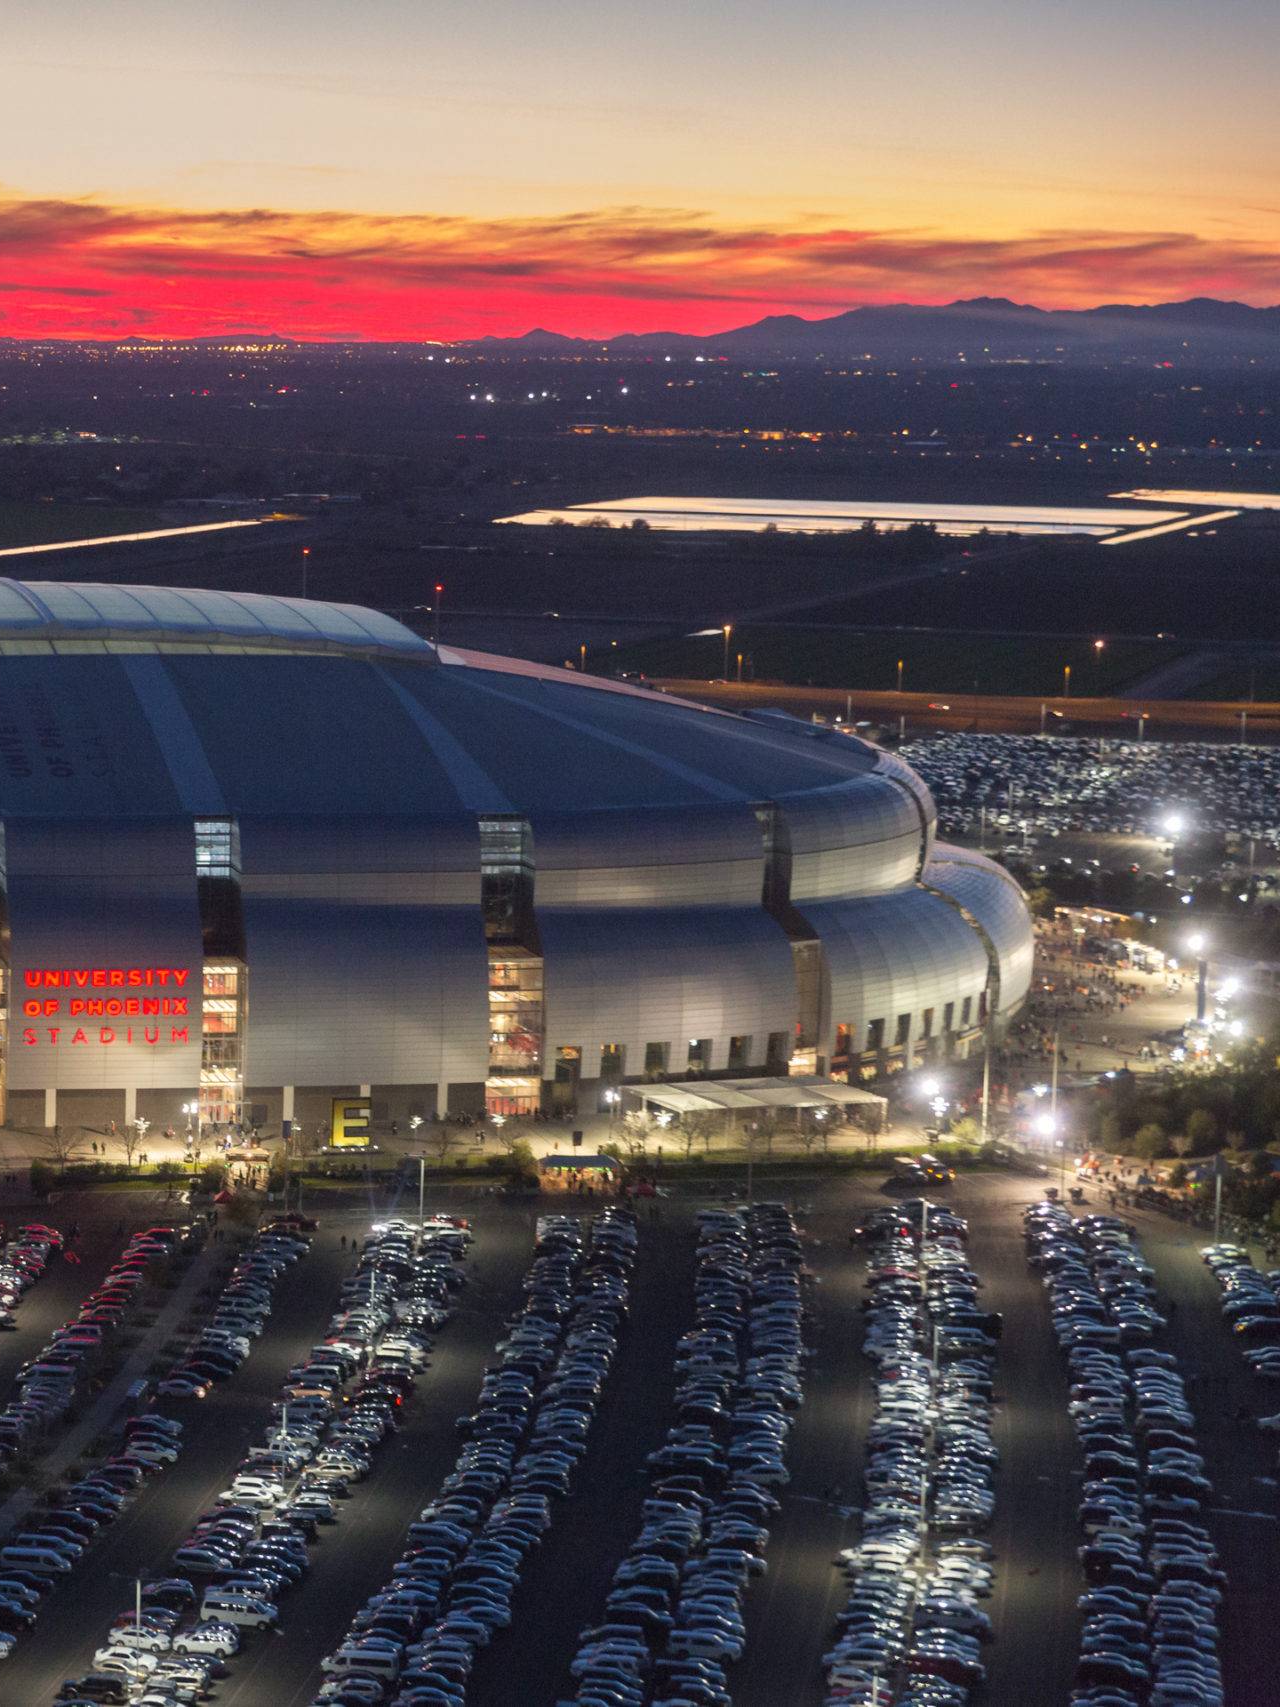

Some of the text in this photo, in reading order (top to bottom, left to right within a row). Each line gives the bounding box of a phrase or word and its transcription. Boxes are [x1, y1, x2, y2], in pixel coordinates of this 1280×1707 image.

[25, 969, 189, 987] UNIVERSITY
[23, 998, 188, 1016] OF PHOENIX
[23, 1027, 189, 1045] STADIUM
[332, 1097, 372, 1147] E
